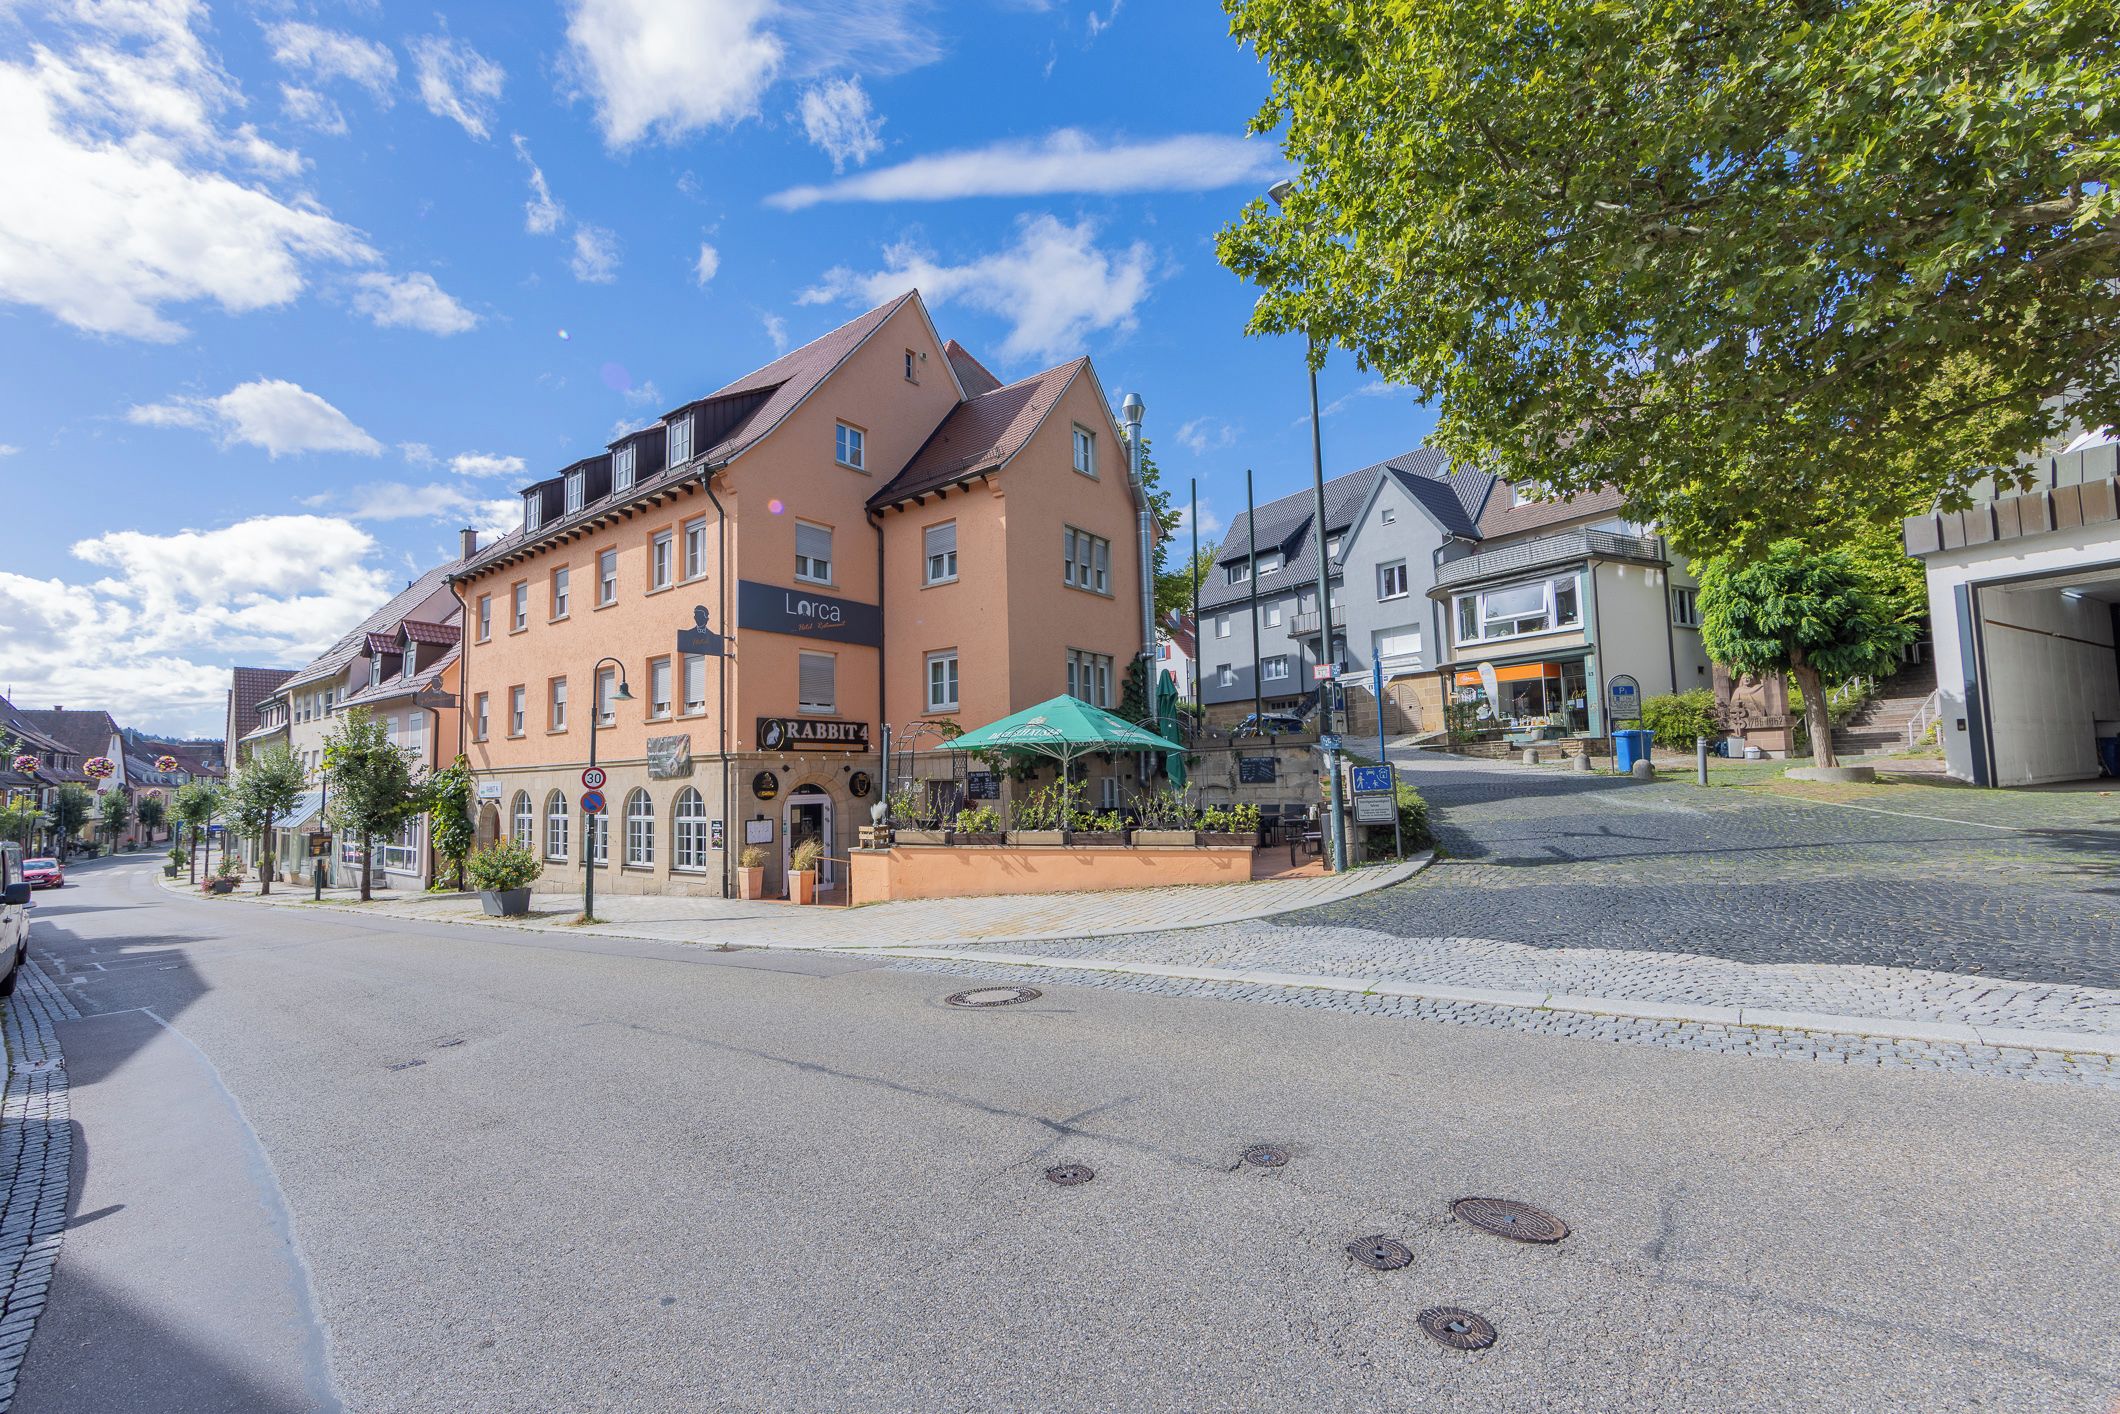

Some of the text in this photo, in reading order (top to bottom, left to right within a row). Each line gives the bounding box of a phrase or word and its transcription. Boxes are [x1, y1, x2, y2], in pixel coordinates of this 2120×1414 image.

[786, 592, 840, 622] Lorca
[786, 722, 868, 740] RABBIT 4
[586, 773, 602, 784] 30
